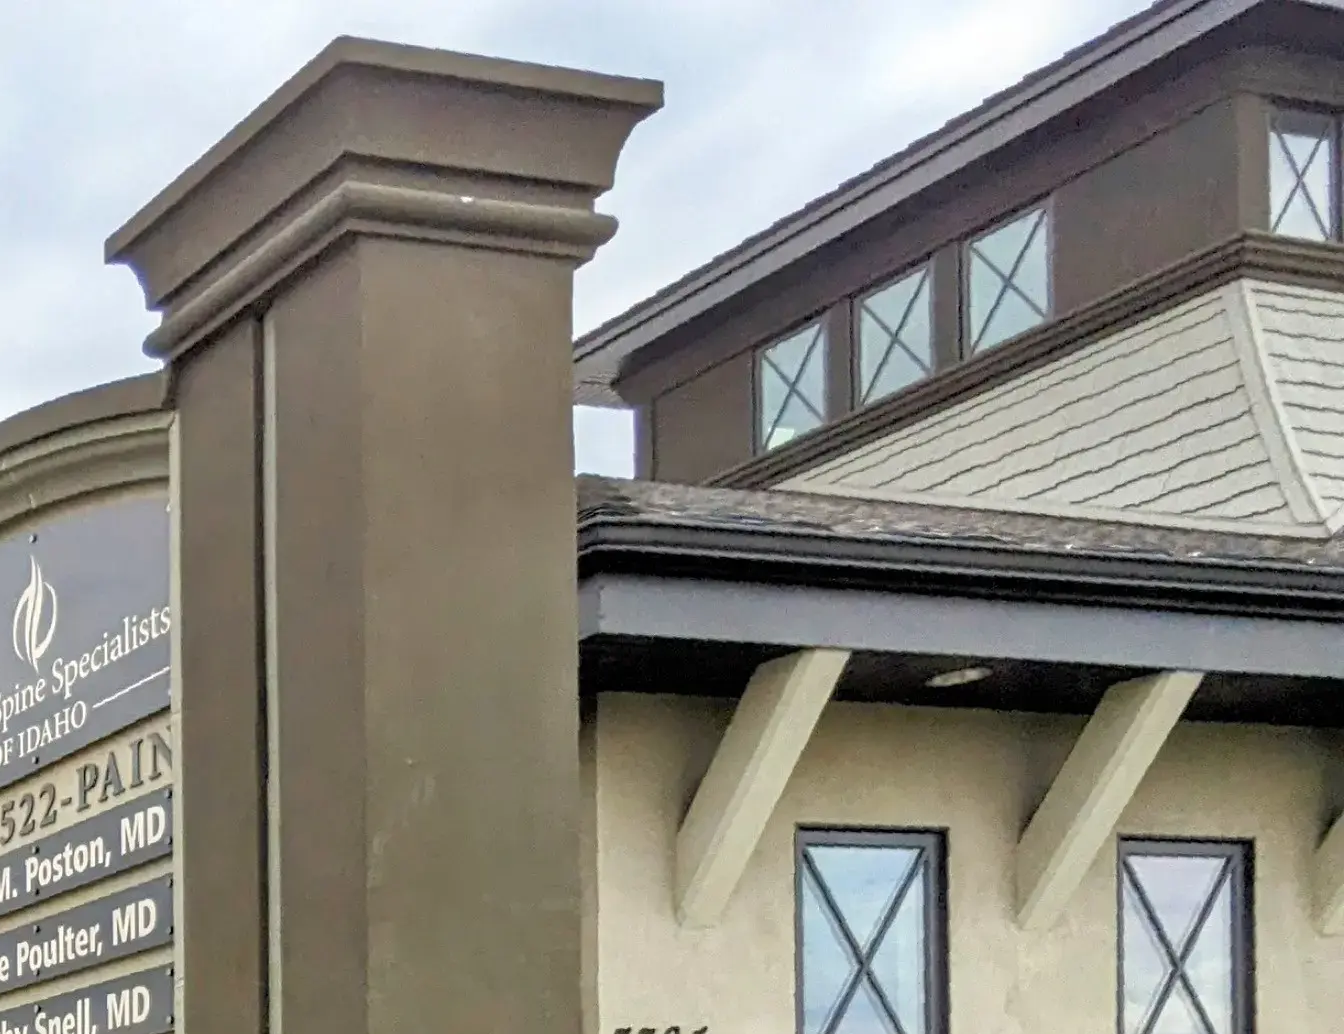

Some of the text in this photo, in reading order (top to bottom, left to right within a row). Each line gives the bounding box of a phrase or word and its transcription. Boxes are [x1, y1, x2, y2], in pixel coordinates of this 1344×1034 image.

[52, 606, 171, 699] Specialists
[18, 701, 86, 757] IDAHO
[25, 836, 111, 893] Poston,
[120, 805, 166, 856] MD
[16, 923, 103, 976] Poulter,
[112, 898, 157, 946] MD
[106, 985, 151, 1030] MD
